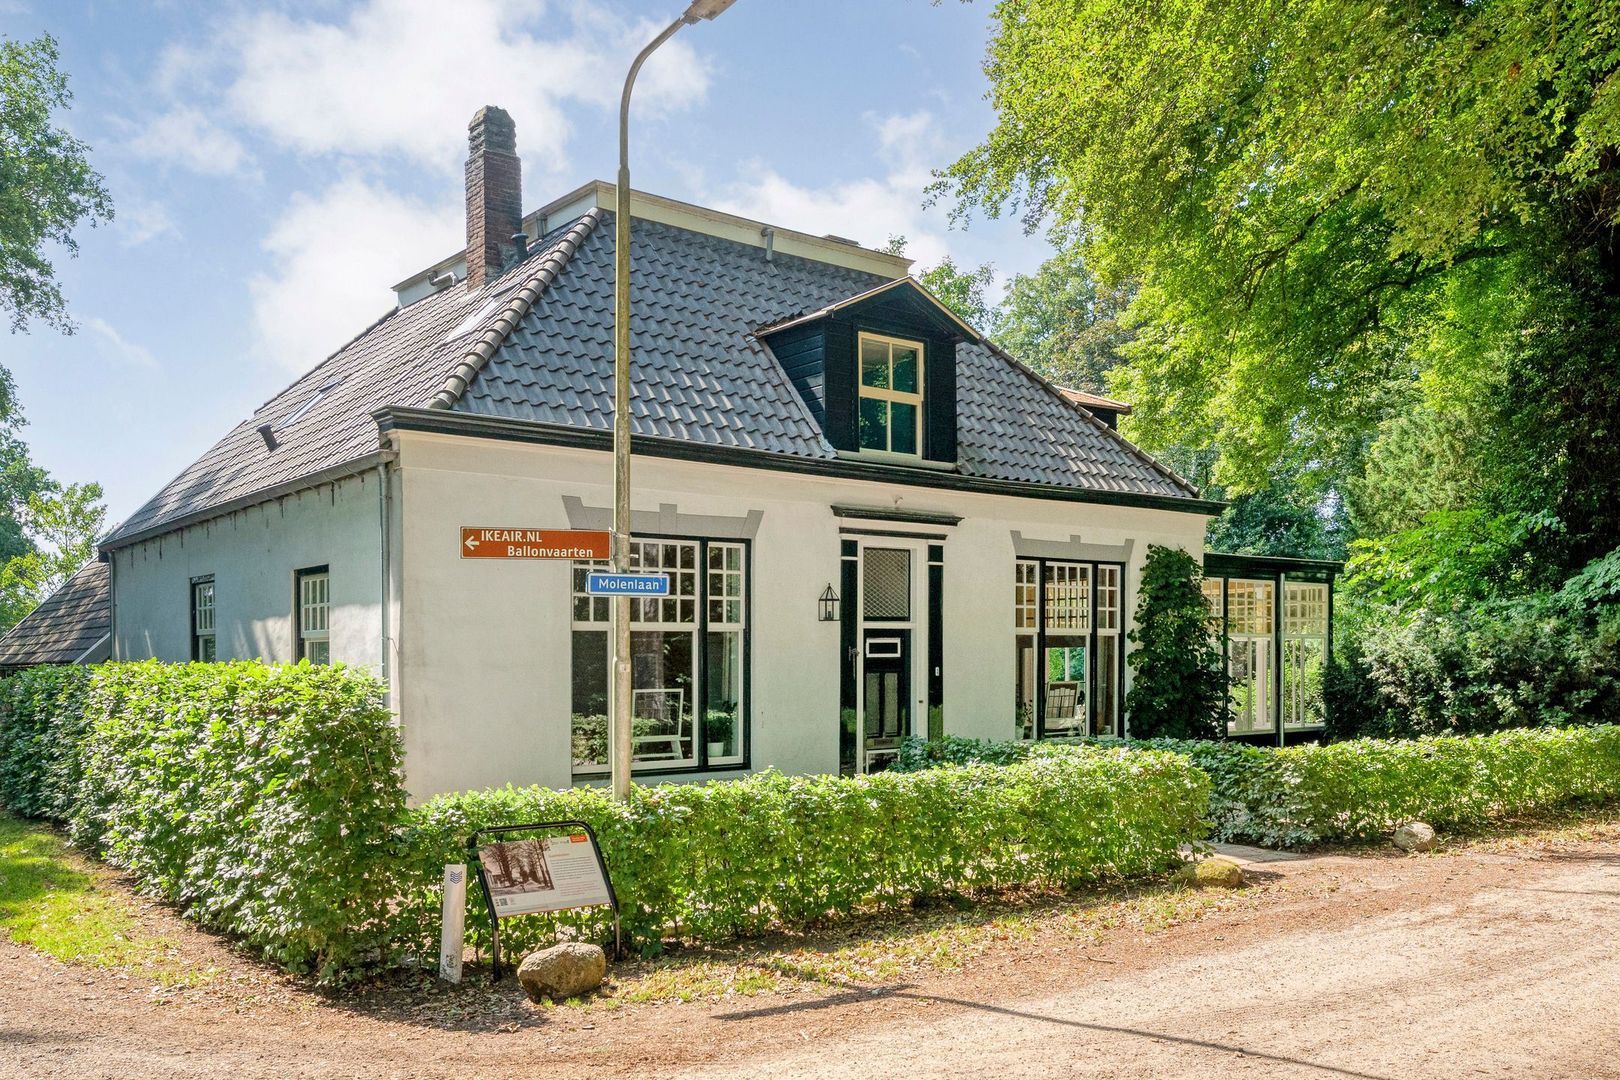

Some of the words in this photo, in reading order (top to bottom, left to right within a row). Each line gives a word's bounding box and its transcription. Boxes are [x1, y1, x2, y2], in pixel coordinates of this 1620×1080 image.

[481, 530, 542, 542] IKEAIR.NL
[507, 546, 593, 558] Ballonvaarten
[598, 578, 659, 590] Molenlaan
